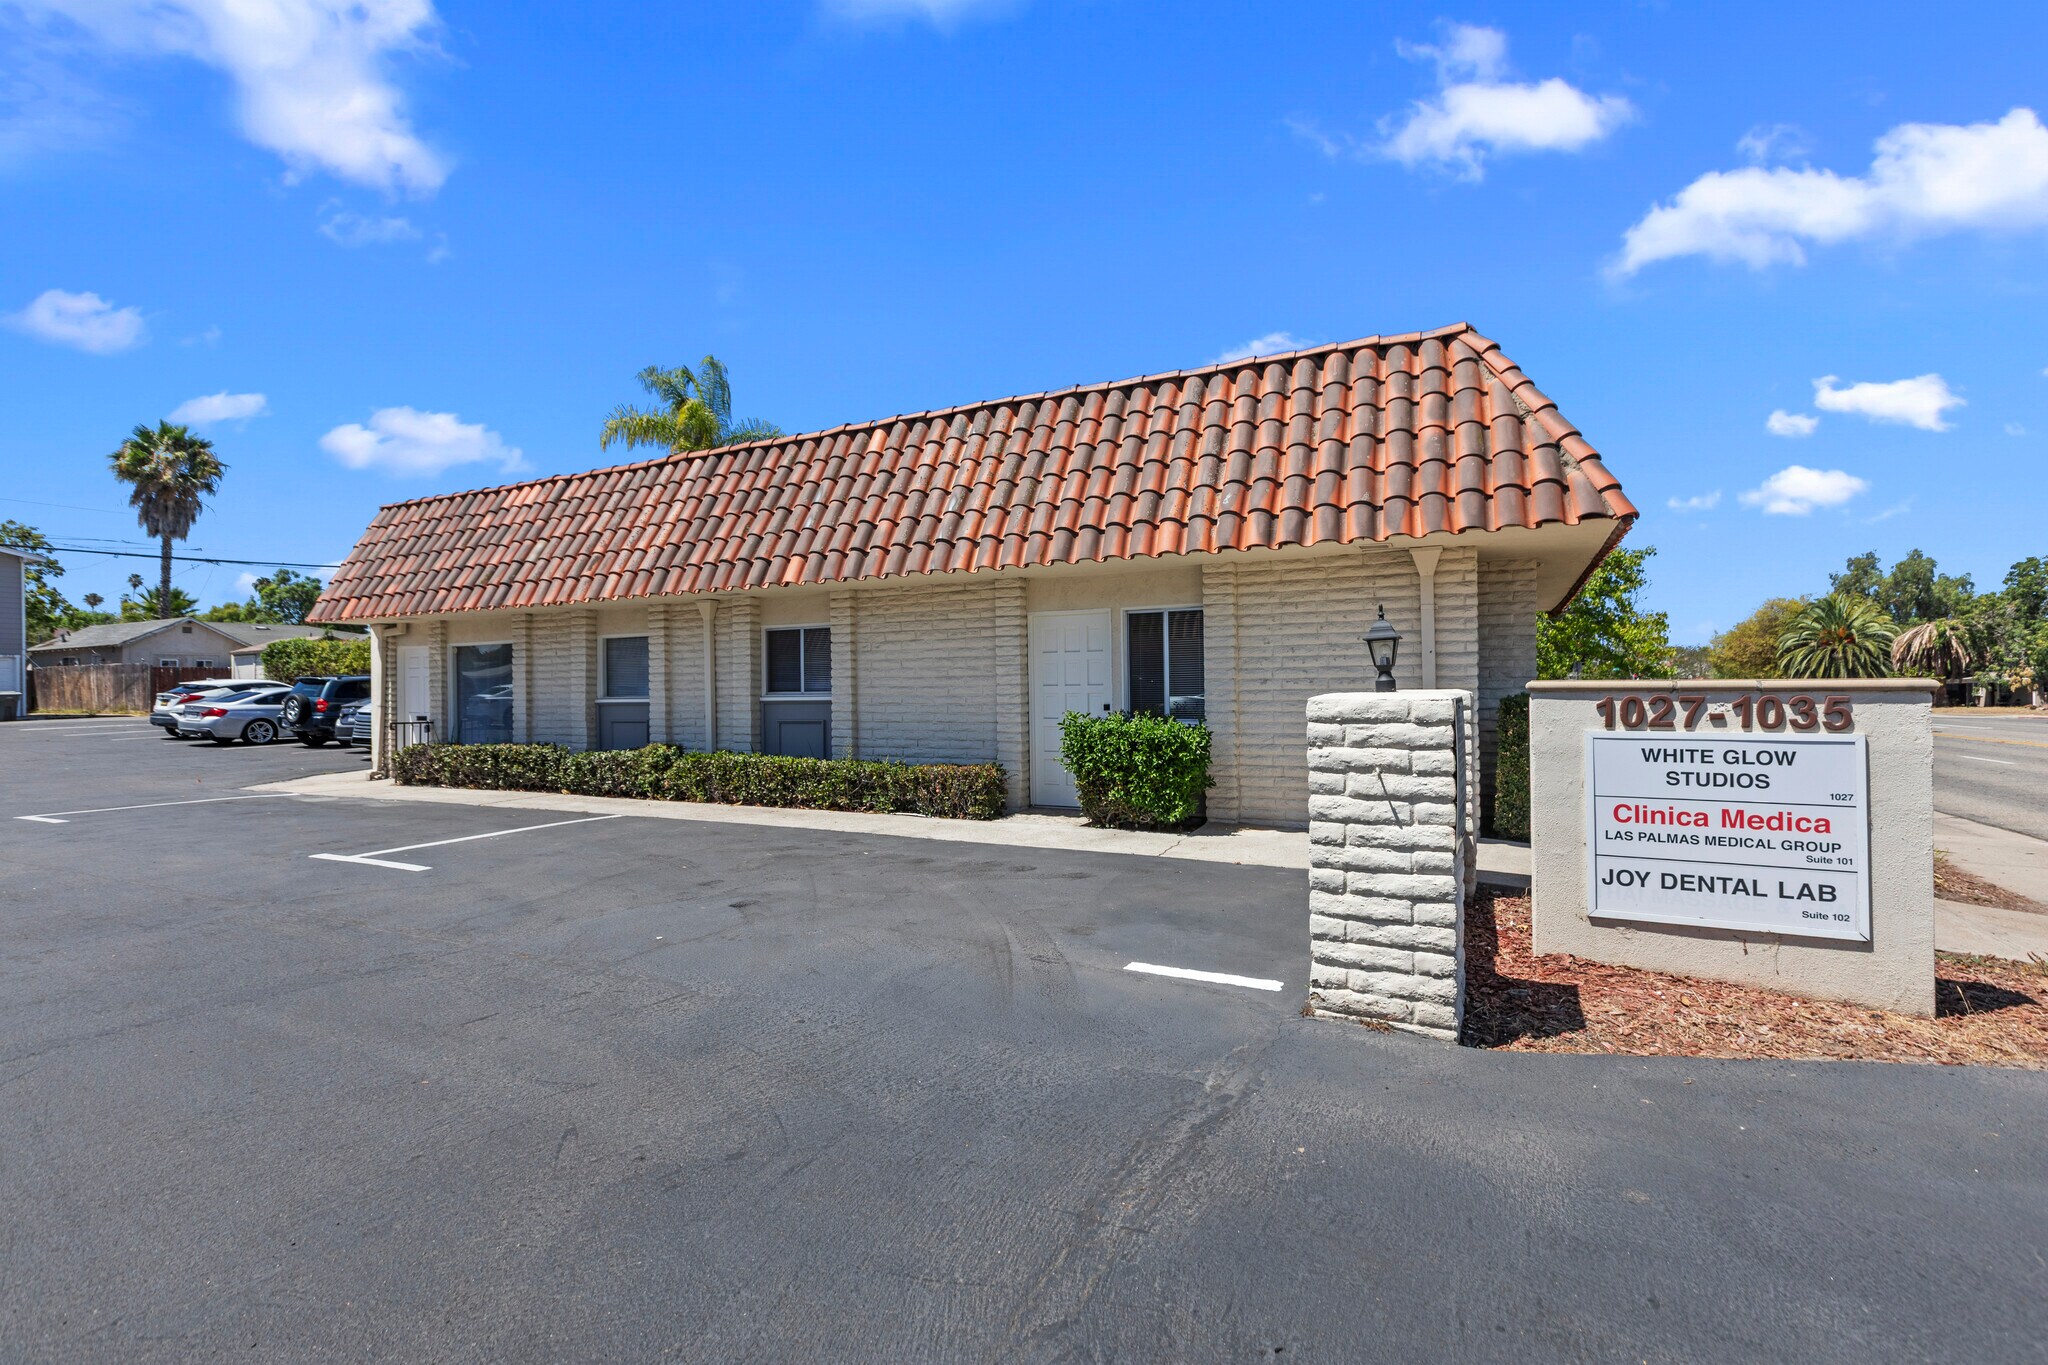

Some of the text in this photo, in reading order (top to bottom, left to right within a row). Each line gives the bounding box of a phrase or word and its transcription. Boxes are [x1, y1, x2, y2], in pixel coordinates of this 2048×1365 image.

[1596, 694, 1853, 731] 1027-1035
[1641, 748, 1797, 766] WHITE GLOW
[1665, 771, 1771, 789] STUDIOS
[1829, 793, 1854, 802] 1027
[1613, 804, 1832, 834] Clinica Medica
[1605, 830, 1842, 853] LAS PALMAS MEDICAL GROUP
[1805, 854, 1853, 866] Suite 101
[1602, 869, 1837, 902] JOY DENTAL LAB
[1801, 910, 1850, 922] Suite 102
